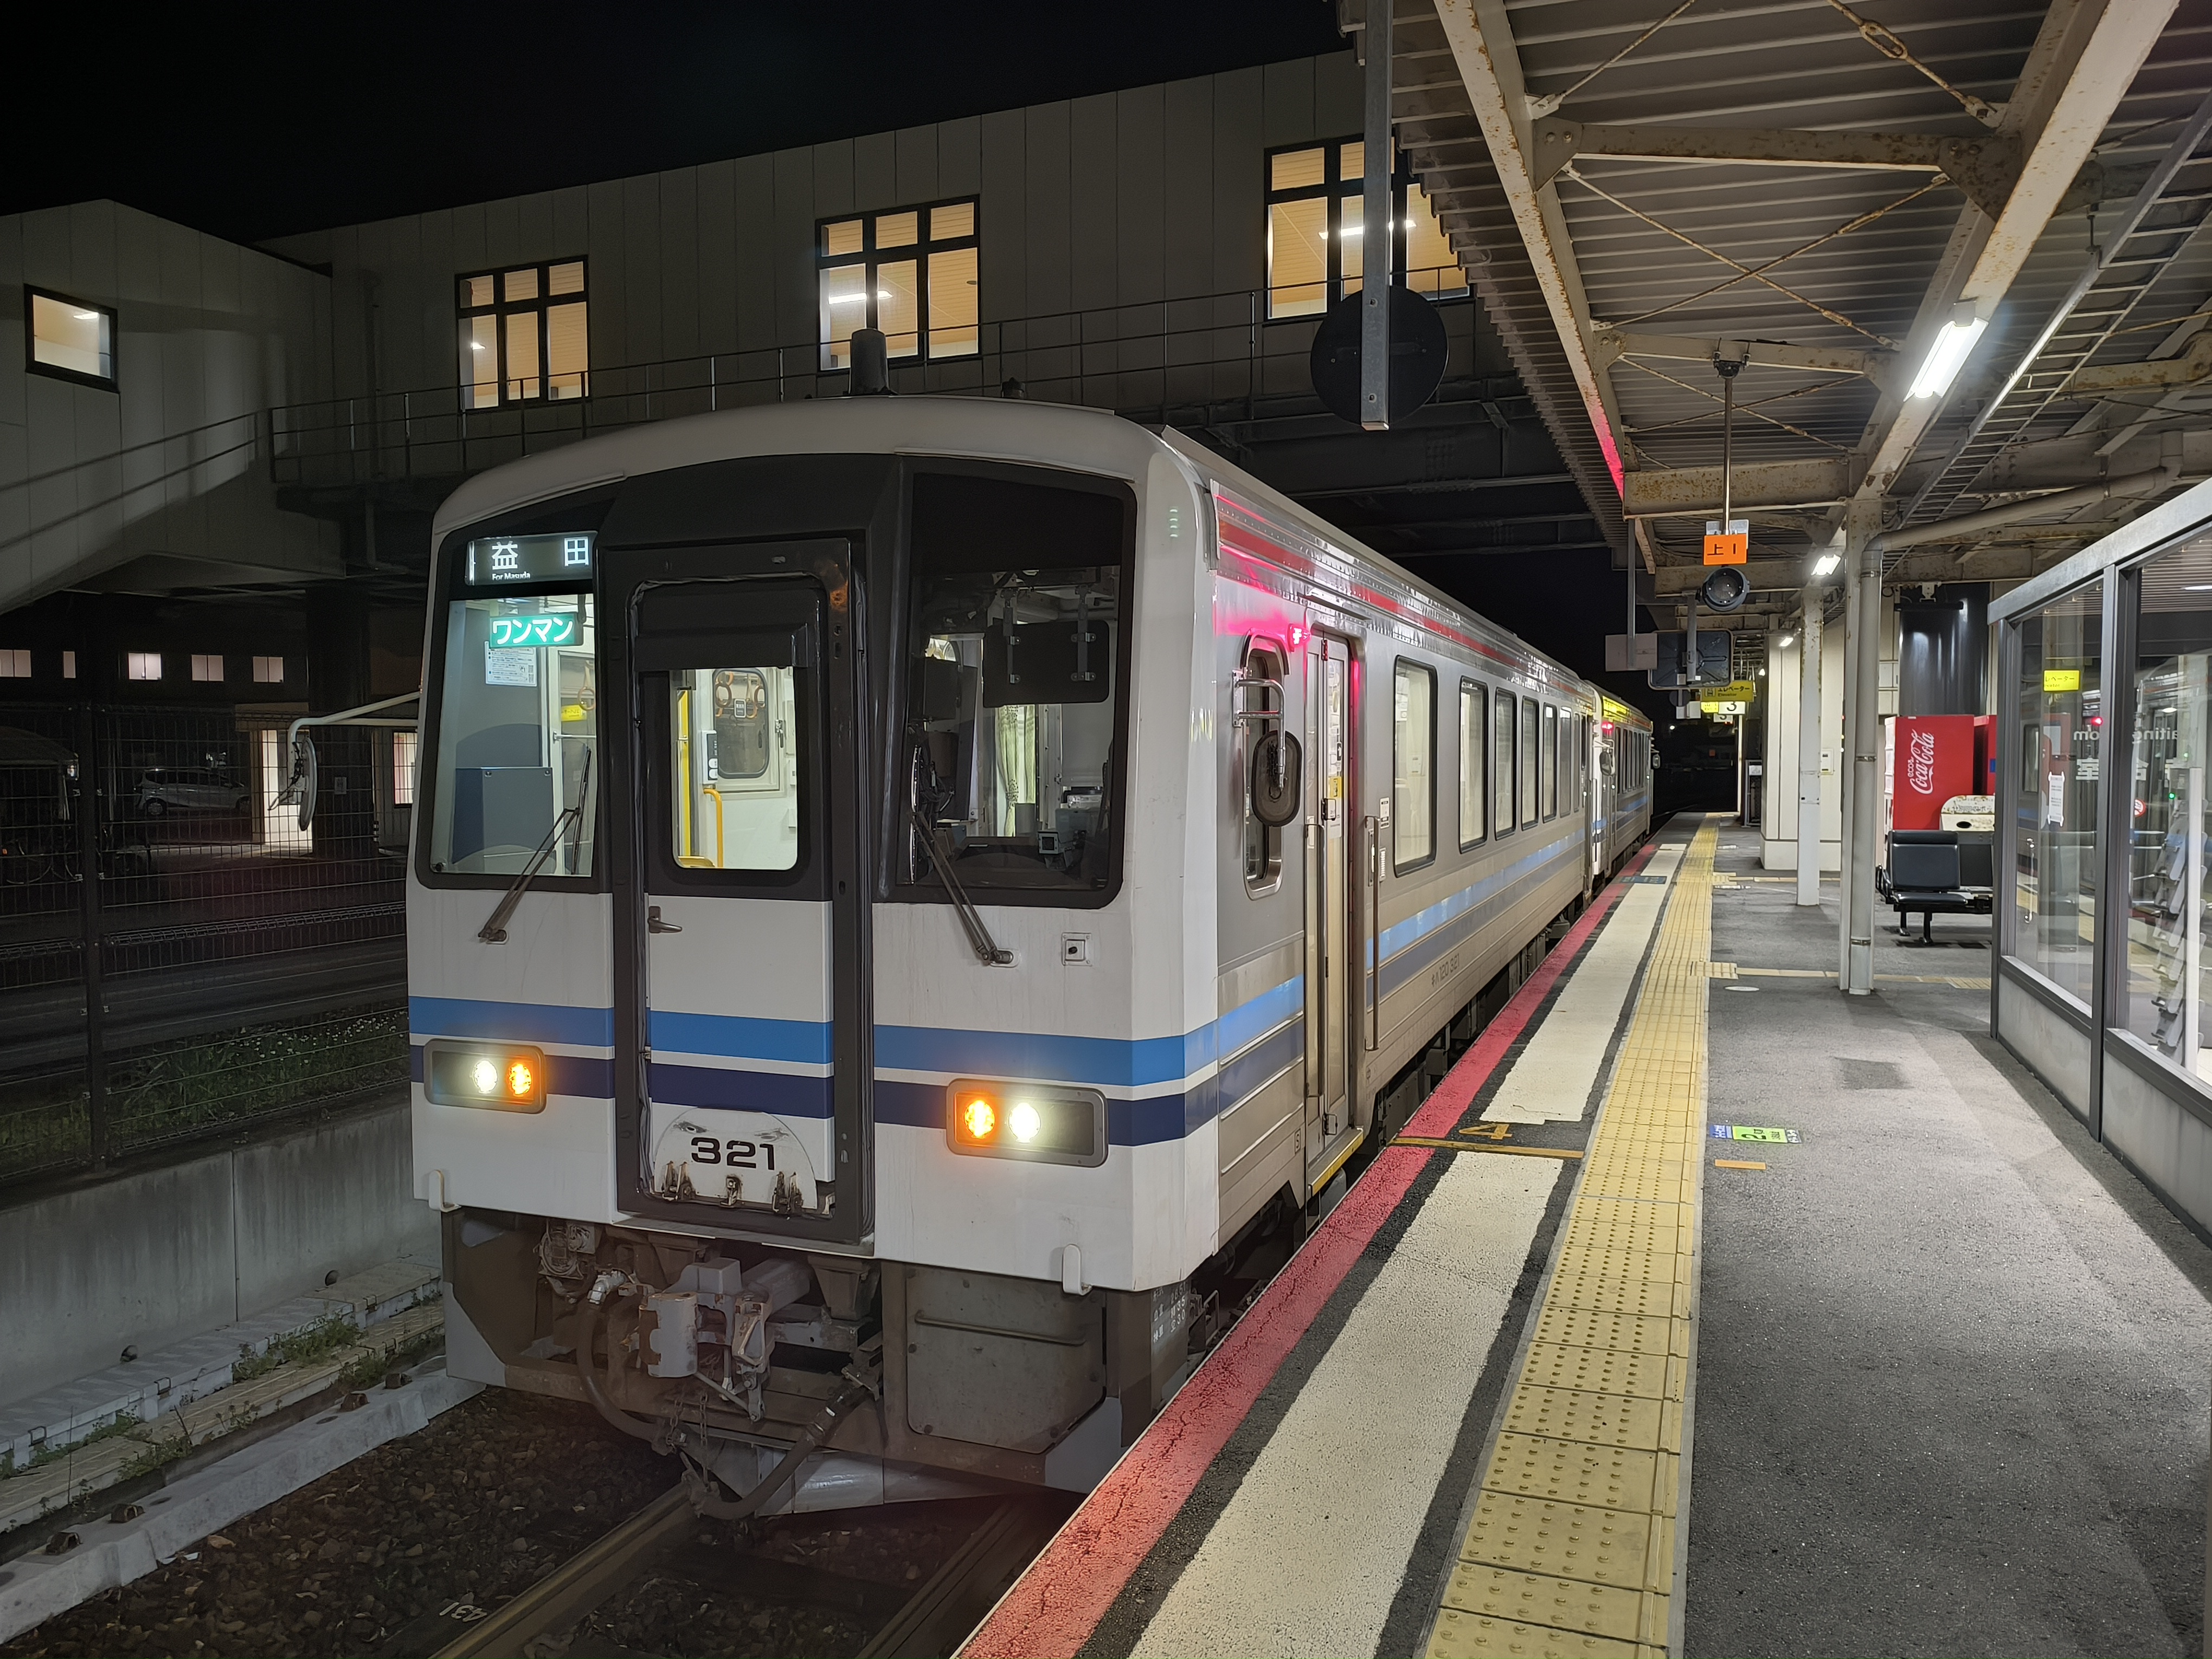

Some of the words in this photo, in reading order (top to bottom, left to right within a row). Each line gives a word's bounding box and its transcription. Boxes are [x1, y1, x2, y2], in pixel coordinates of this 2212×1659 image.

[492, 573, 503, 581] For
[504, 571, 531, 580] Masuda
[492, 617, 573, 645] ワンマン
[1726, 702, 1737, 712] 3
[1909, 729, 1934, 794] Coca-Cola
[1431, 972, 1439, 988] キハ
[1439, 961, 1449, 982] 120
[1450, 953, 1460, 974] 321
[691, 1137, 775, 1171] 321
